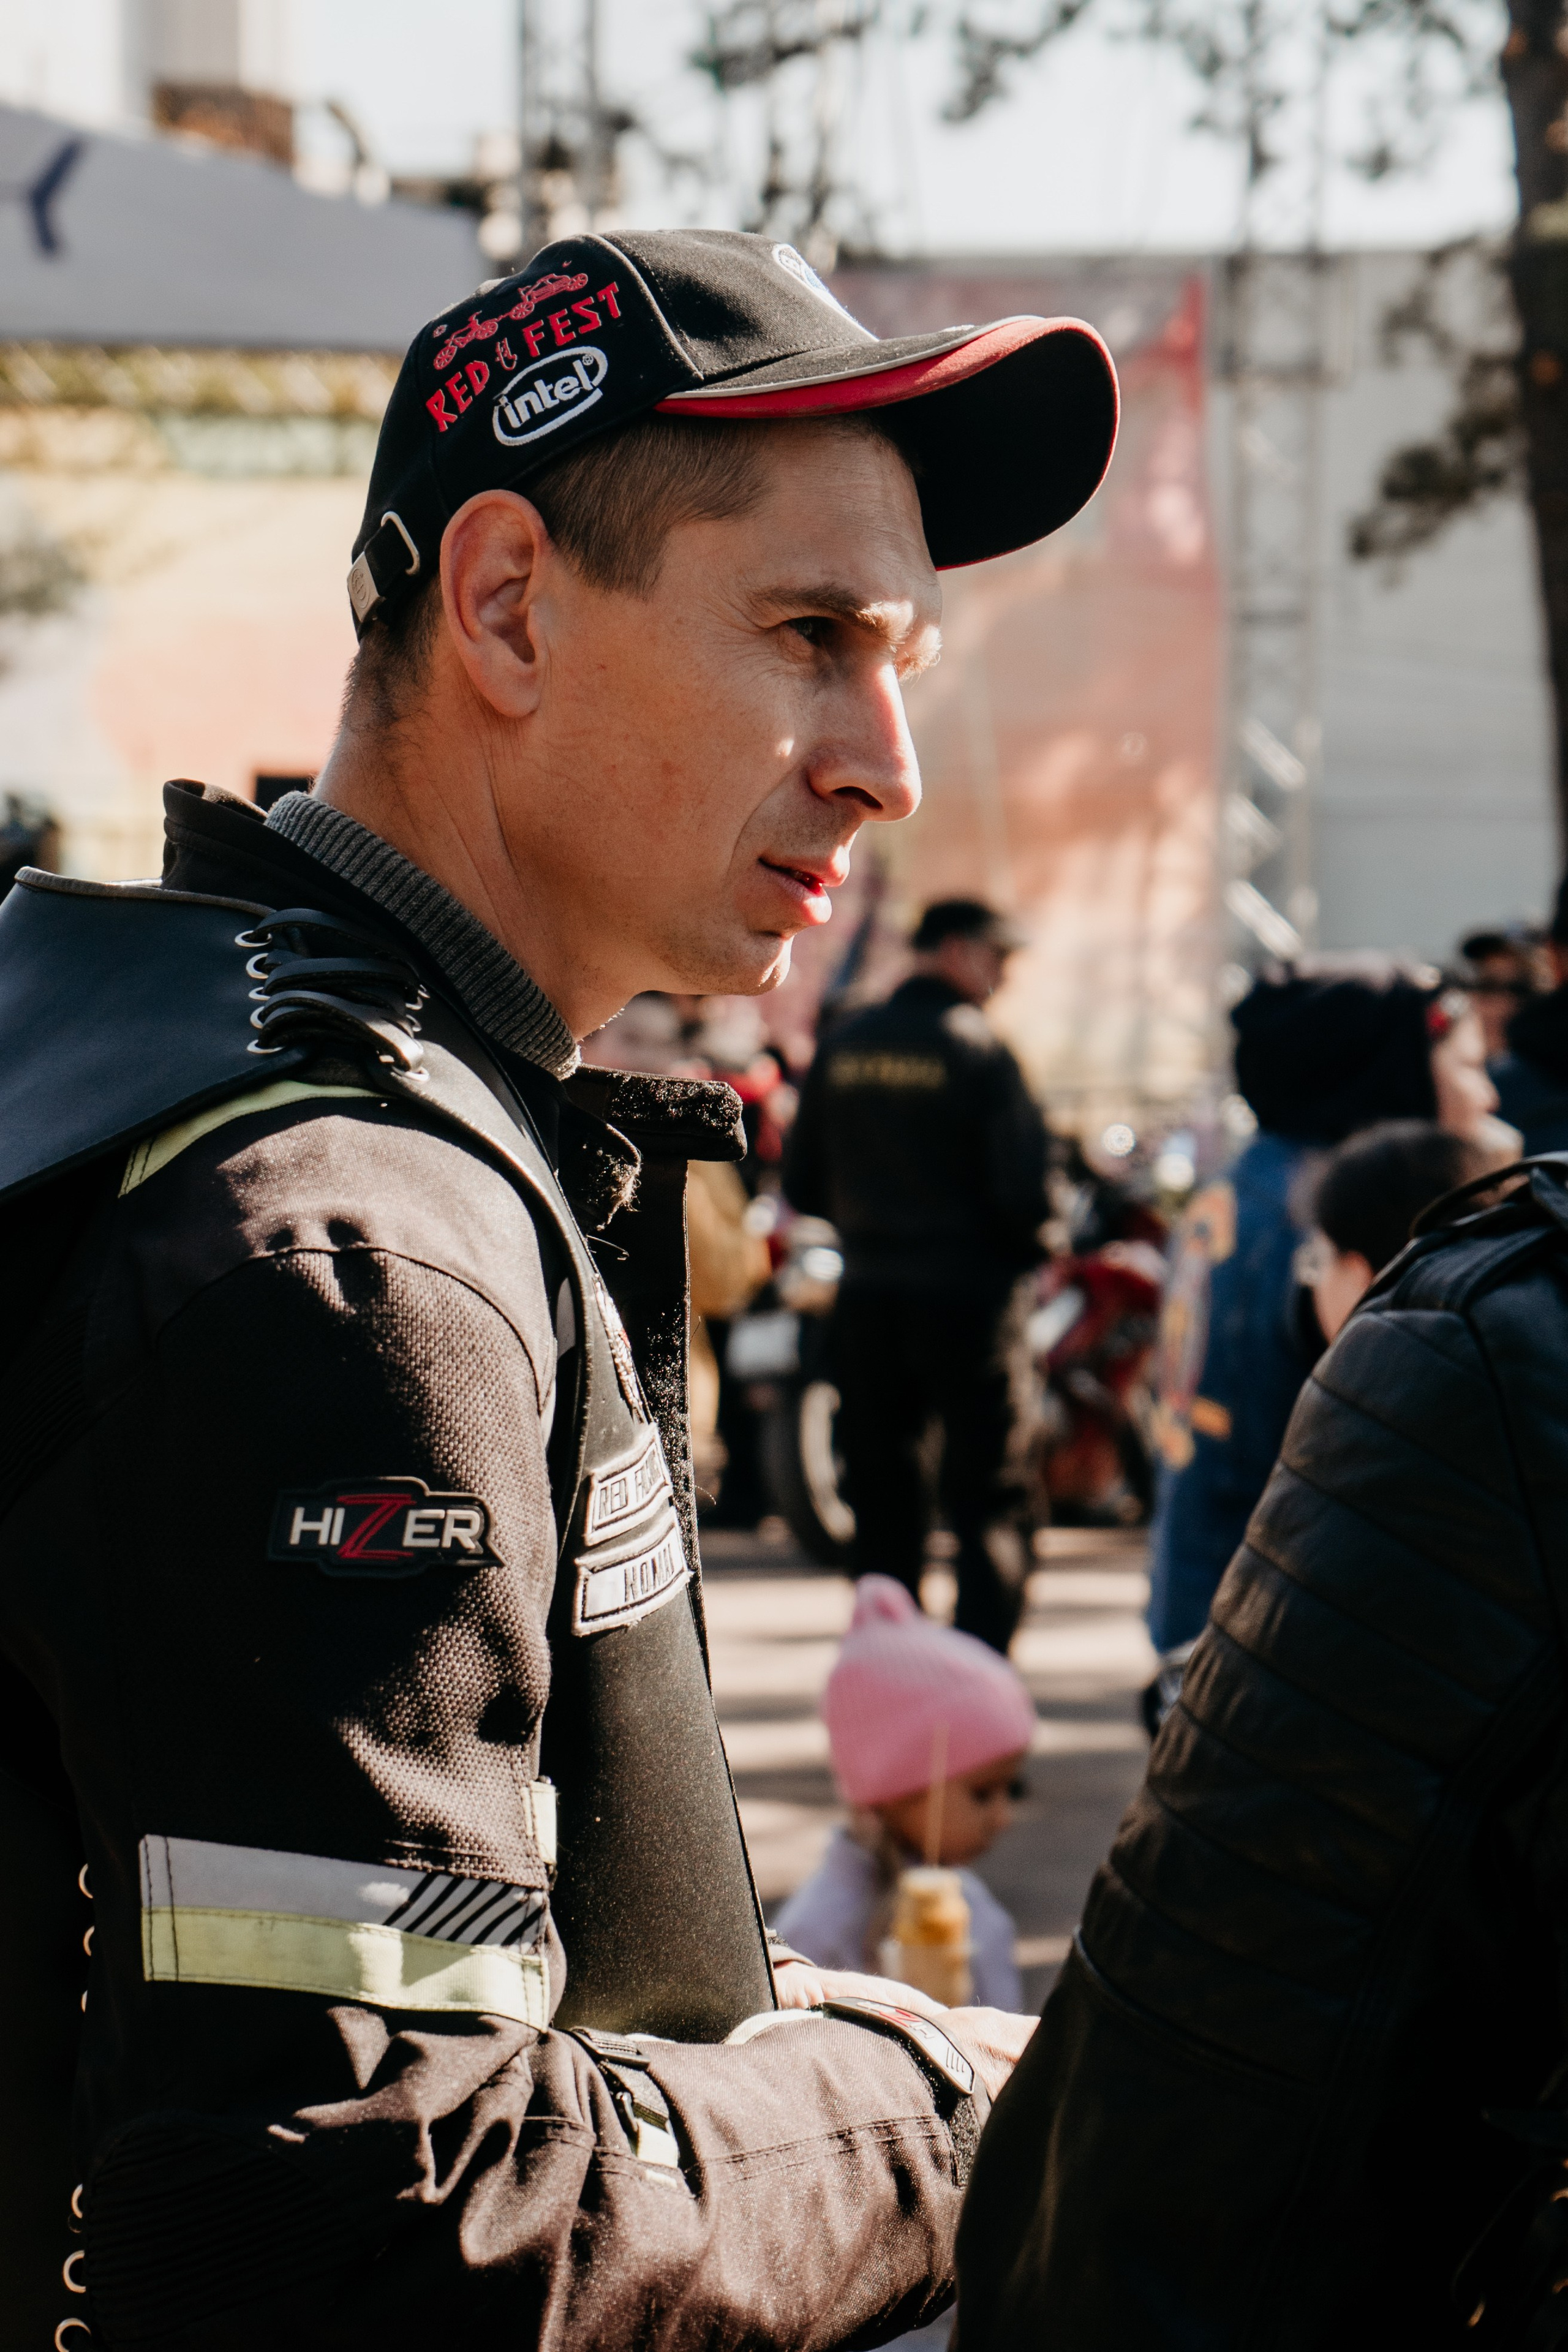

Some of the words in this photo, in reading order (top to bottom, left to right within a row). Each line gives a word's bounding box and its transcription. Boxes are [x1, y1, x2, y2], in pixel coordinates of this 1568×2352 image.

[426, 360, 490, 432] RED
[522, 281, 621, 357] FEST
[499, 359, 594, 429] intel
[289, 1493, 481, 1561] HIZER
